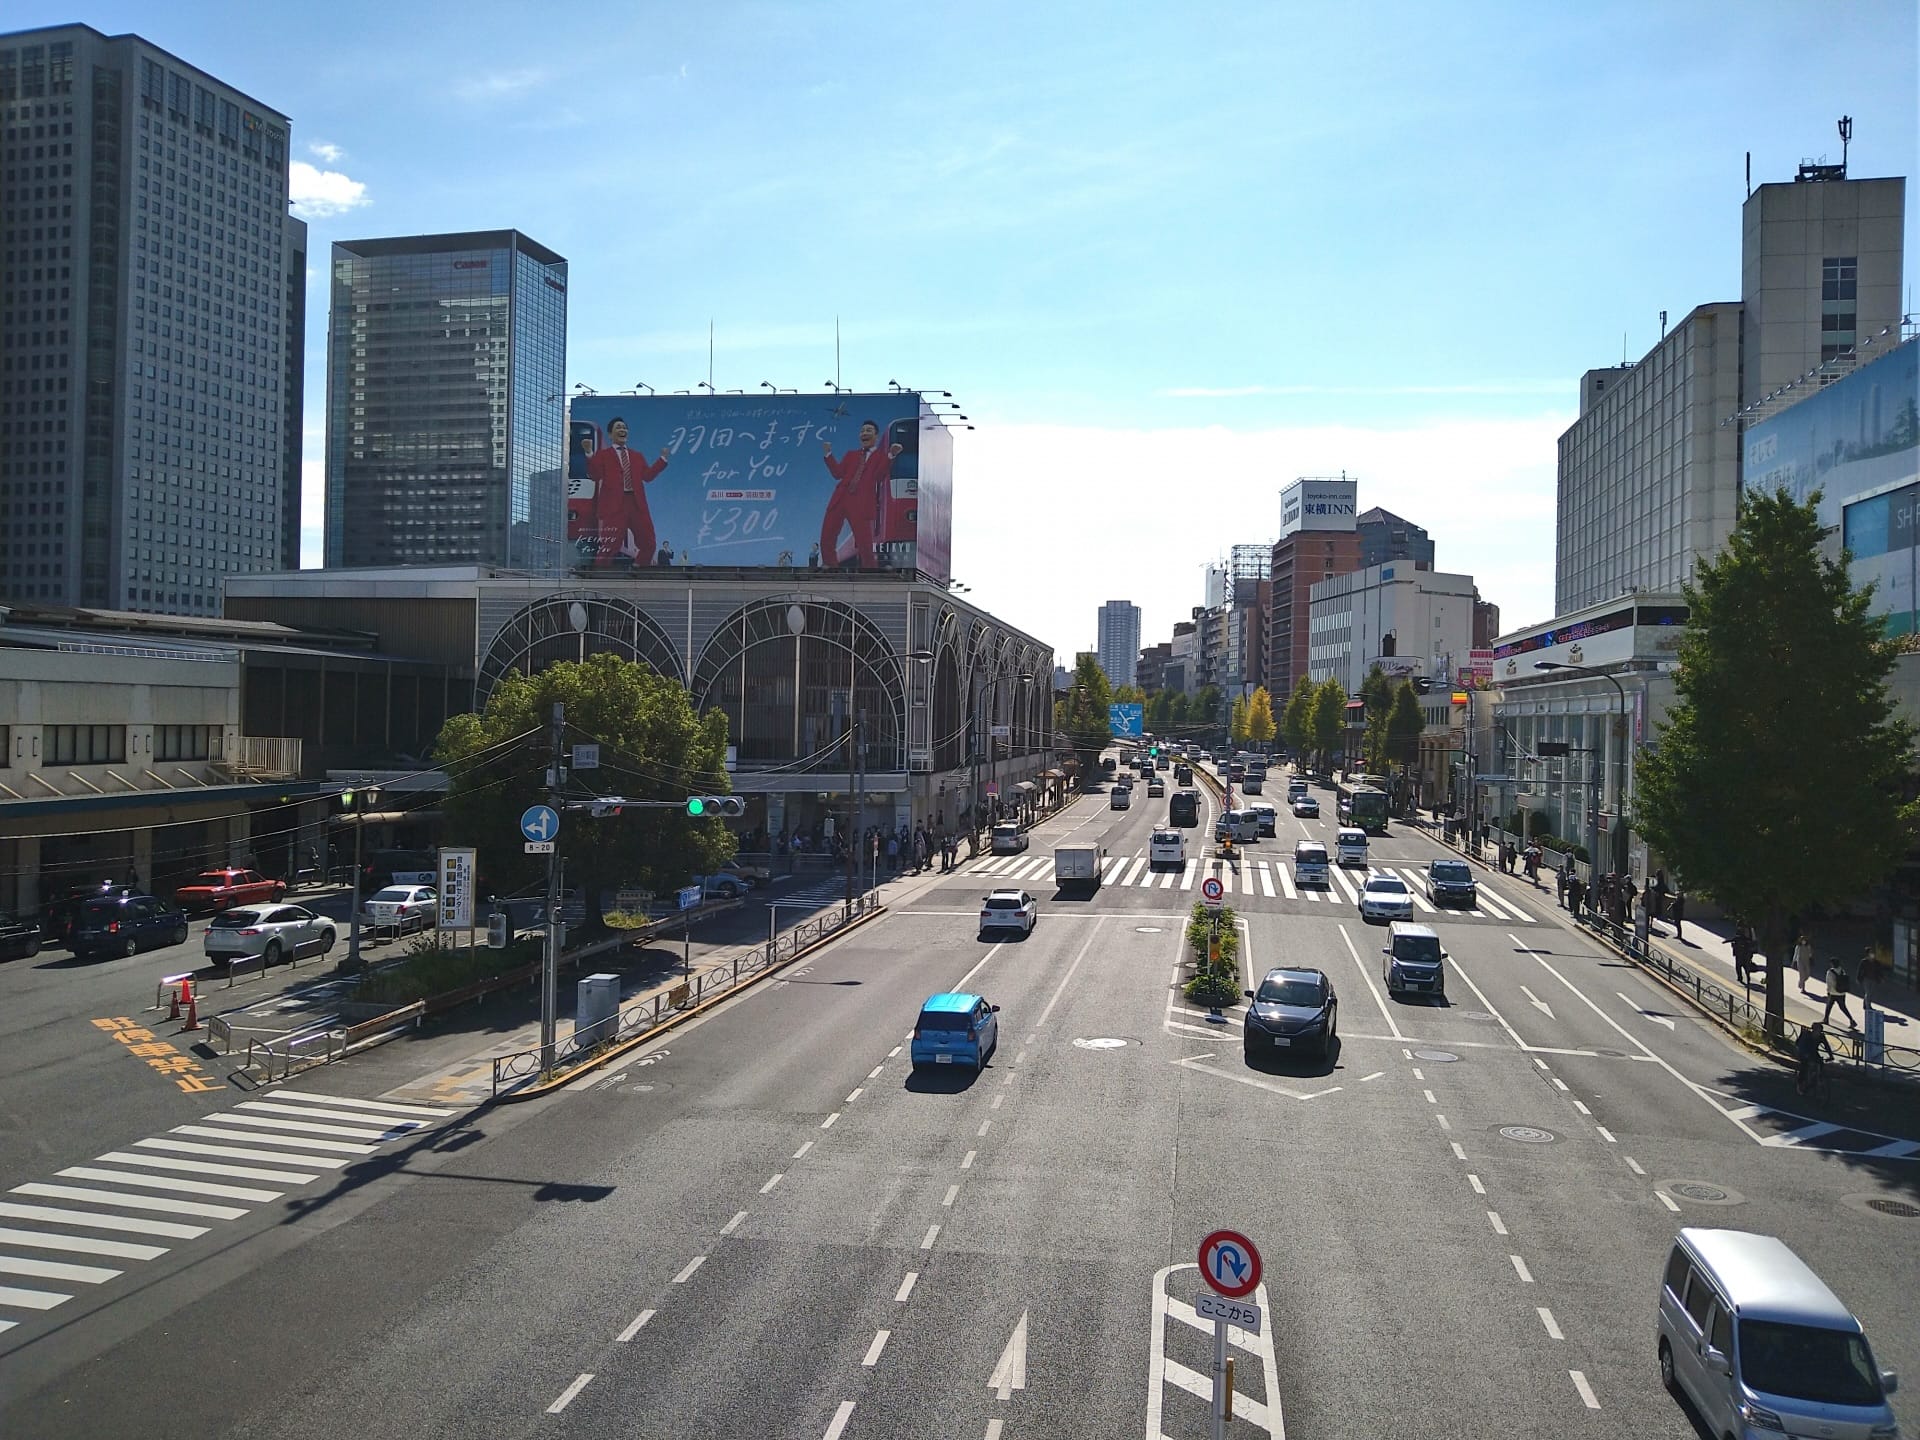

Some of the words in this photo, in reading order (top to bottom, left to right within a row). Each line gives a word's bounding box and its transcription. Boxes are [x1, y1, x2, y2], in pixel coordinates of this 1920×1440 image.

[667, 418, 837, 455] 羽田へまっすぐ
[702, 460, 740, 488] for
[1307, 492, 1352, 500] toyoko-inn.com
[1304, 503, 1355, 515] 東横INN
[697, 507, 779, 545] ¥300
[575, 535, 617, 548] KEIKYU
[872, 542, 911, 553] KEIKYU
[1201, 1299, 1256, 1325] ここから
